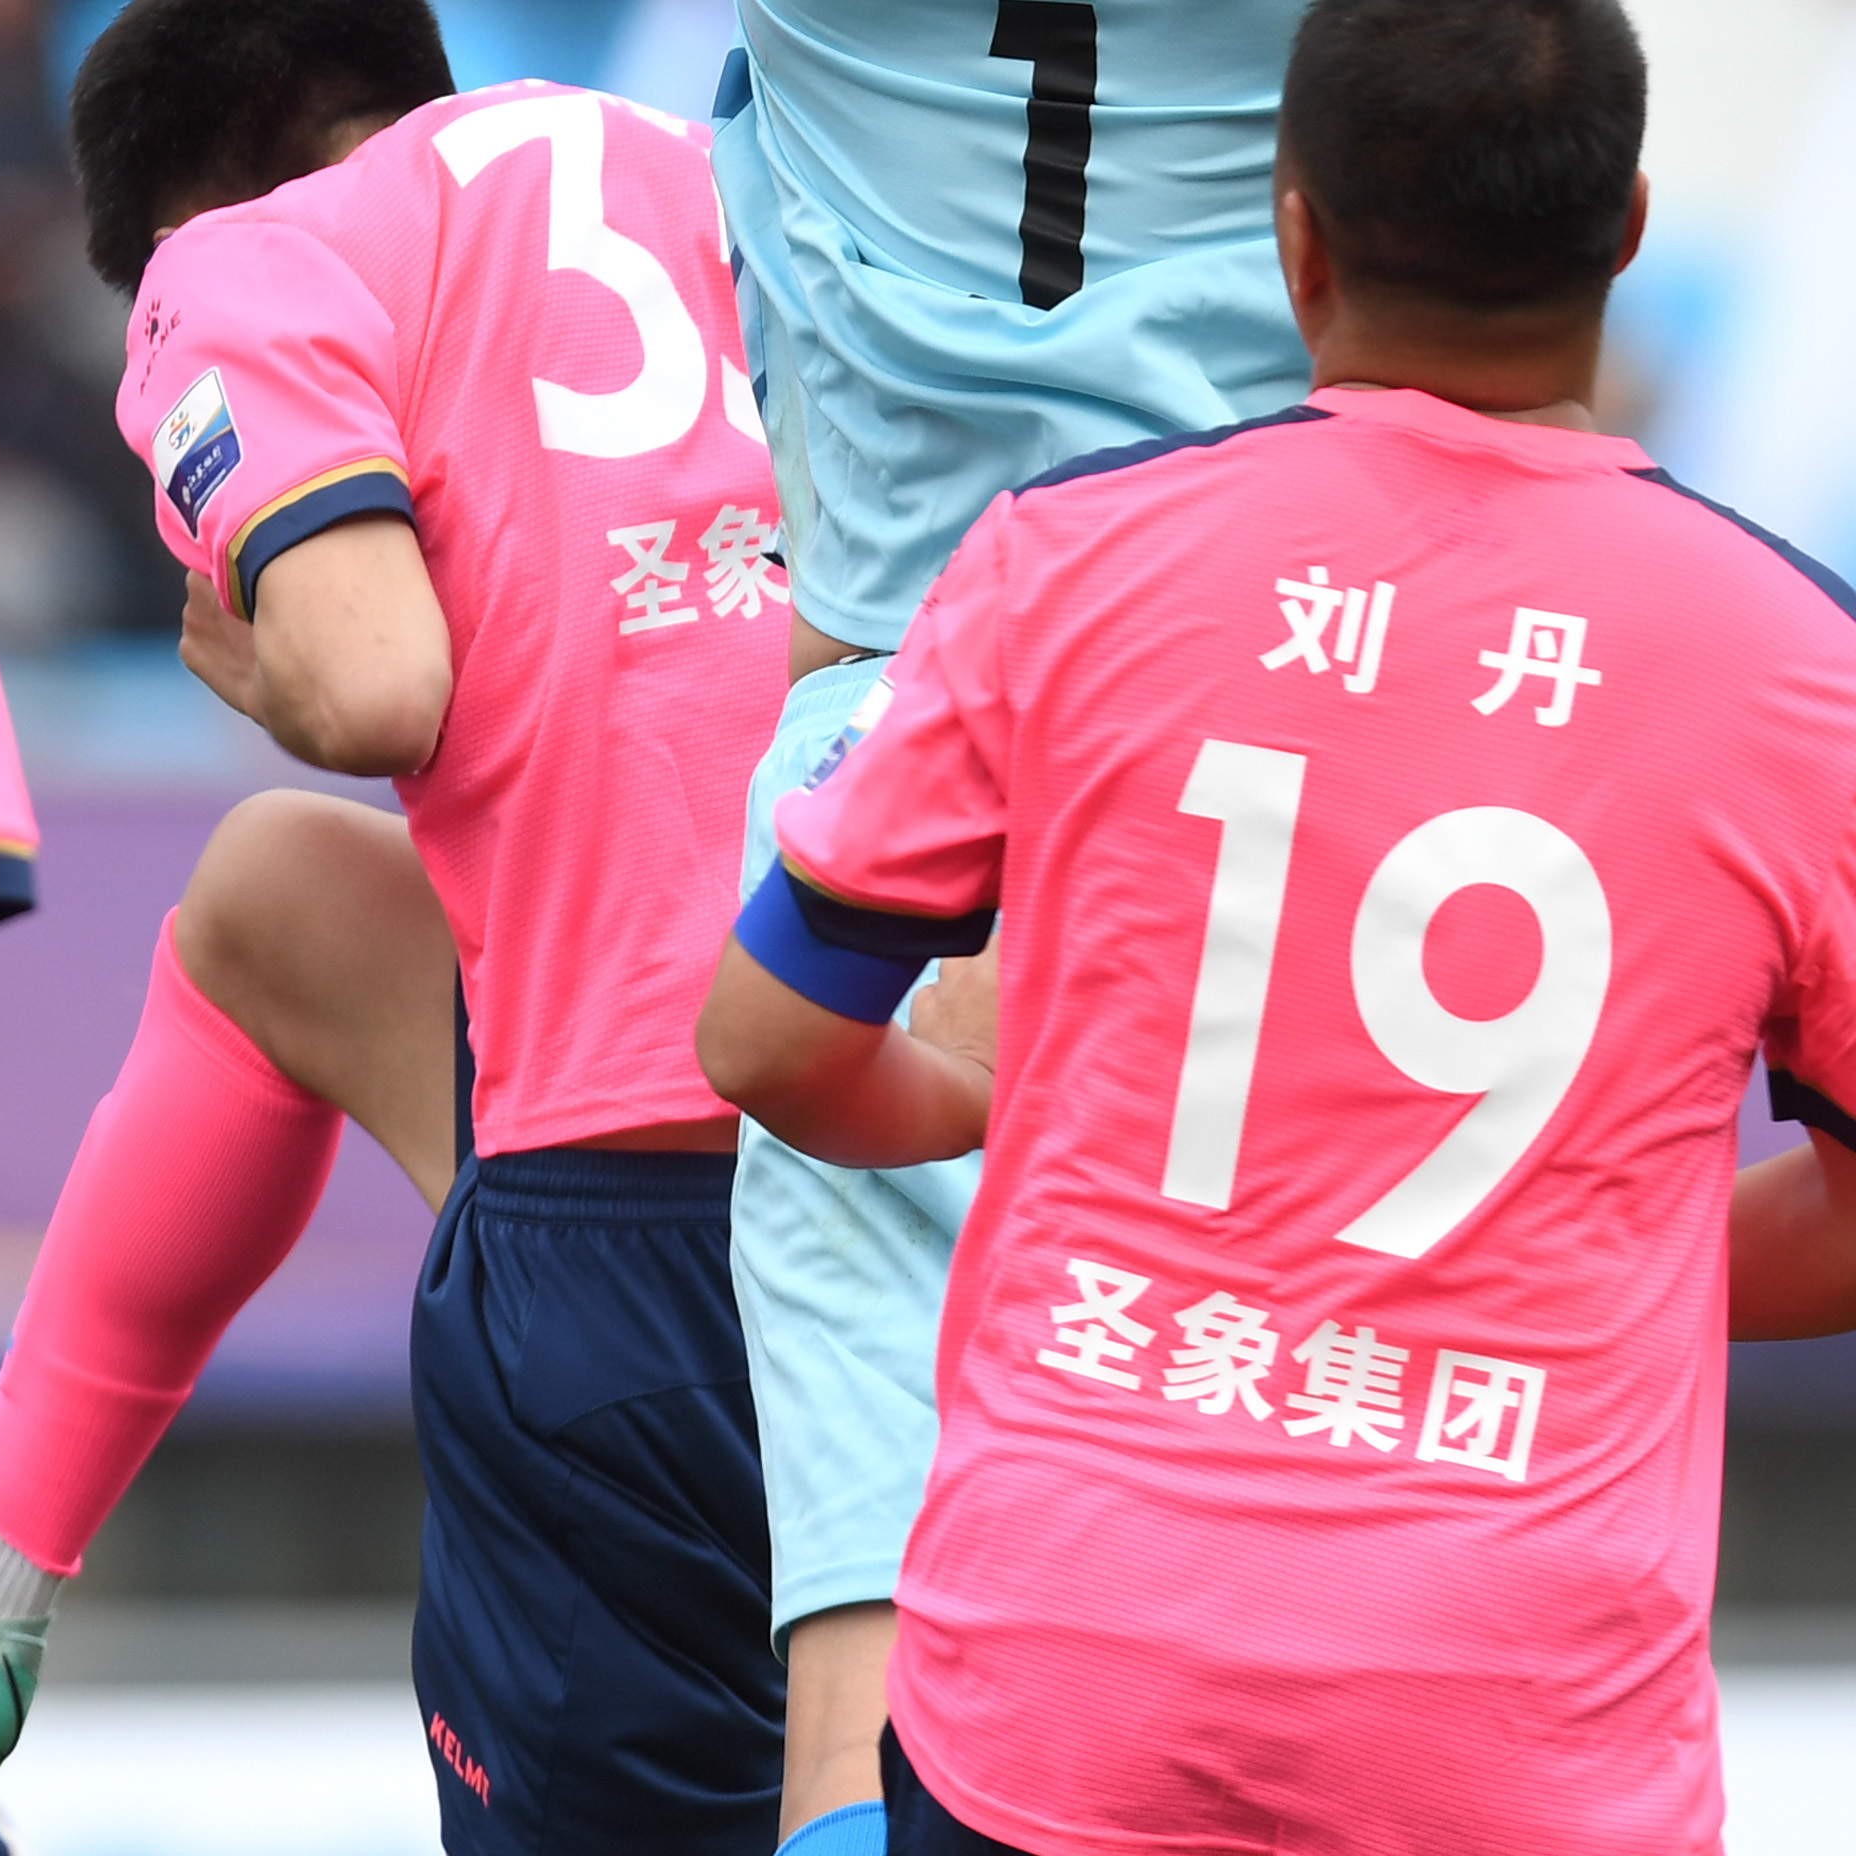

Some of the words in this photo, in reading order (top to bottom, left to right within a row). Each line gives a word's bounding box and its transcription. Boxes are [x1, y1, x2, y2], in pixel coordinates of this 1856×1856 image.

[1160, 738, 1612, 1260] 19
[1036, 1257, 1547, 1483] 圣象集团
